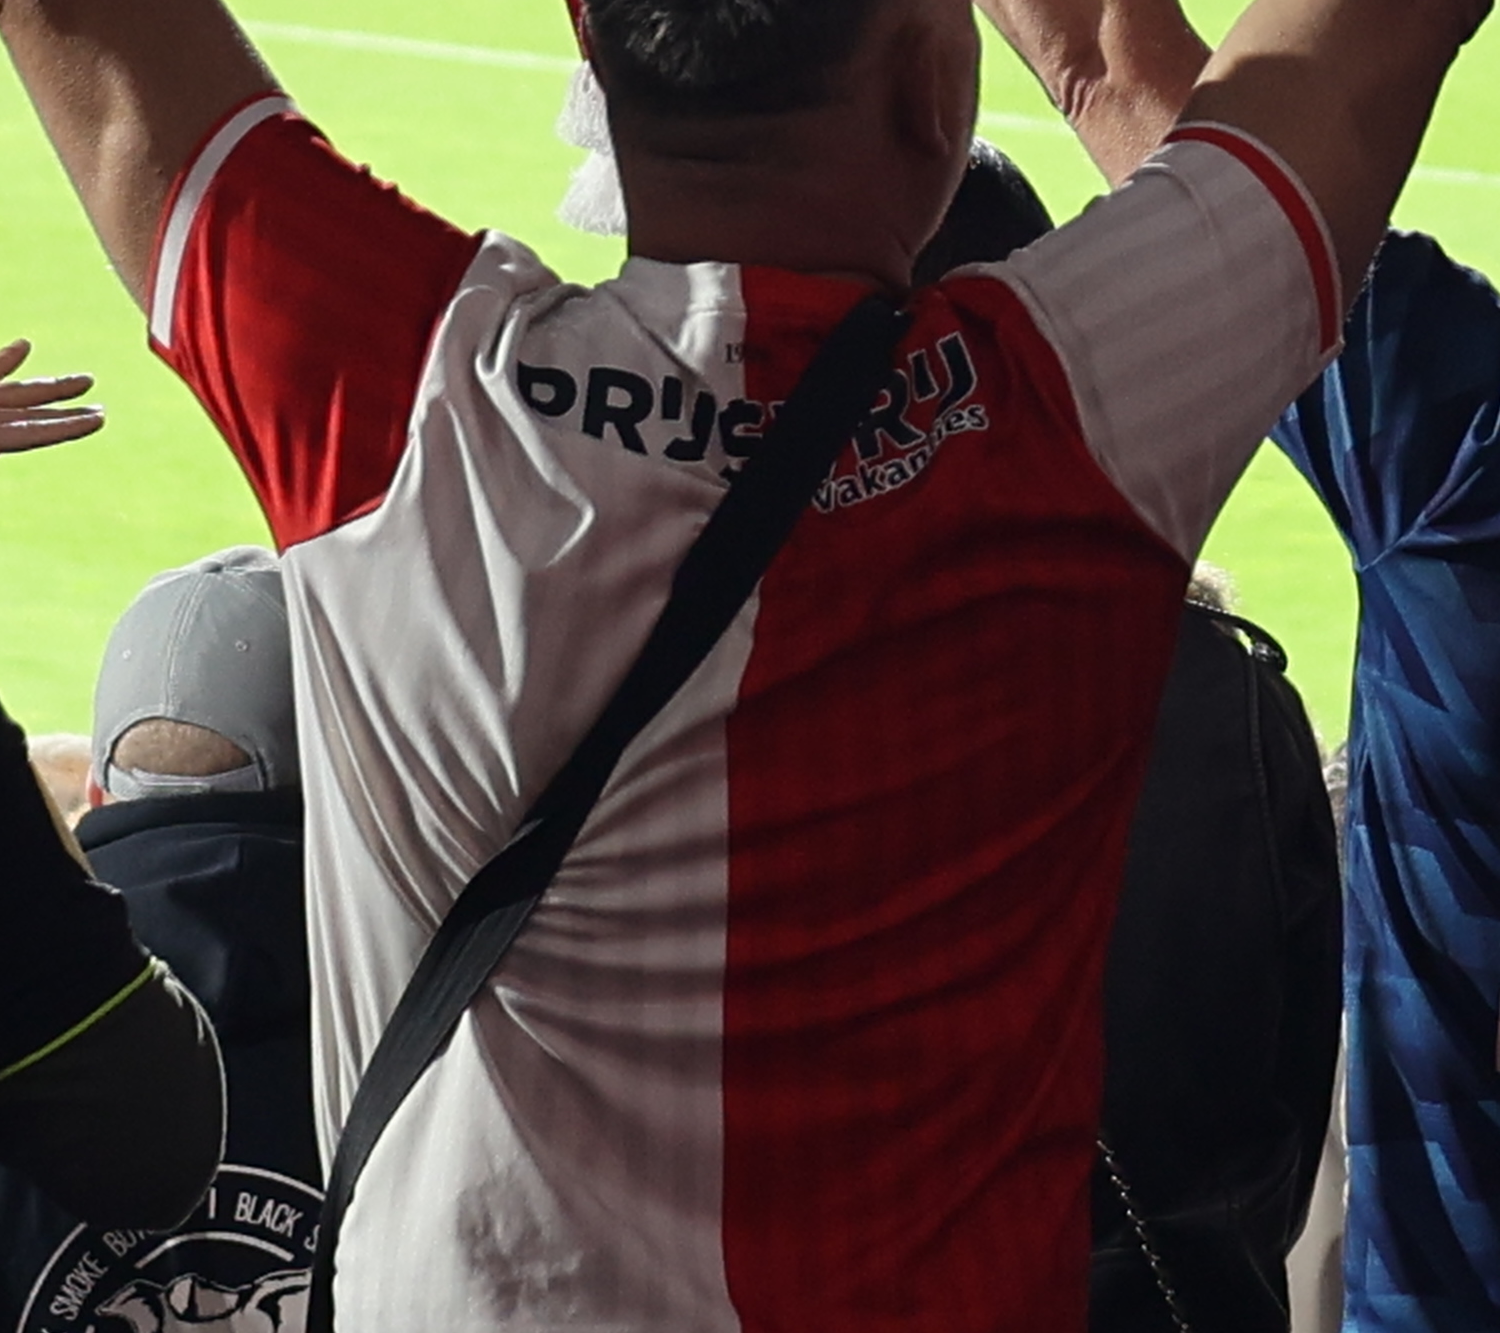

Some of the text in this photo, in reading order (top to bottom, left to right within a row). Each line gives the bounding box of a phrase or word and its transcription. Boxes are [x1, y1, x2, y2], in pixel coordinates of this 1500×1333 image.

[517, 331, 978, 481] PRIJSRIJ
[50, 1250, 109, 1321] SMOKE
[234, 1190, 304, 1238] BLACK
